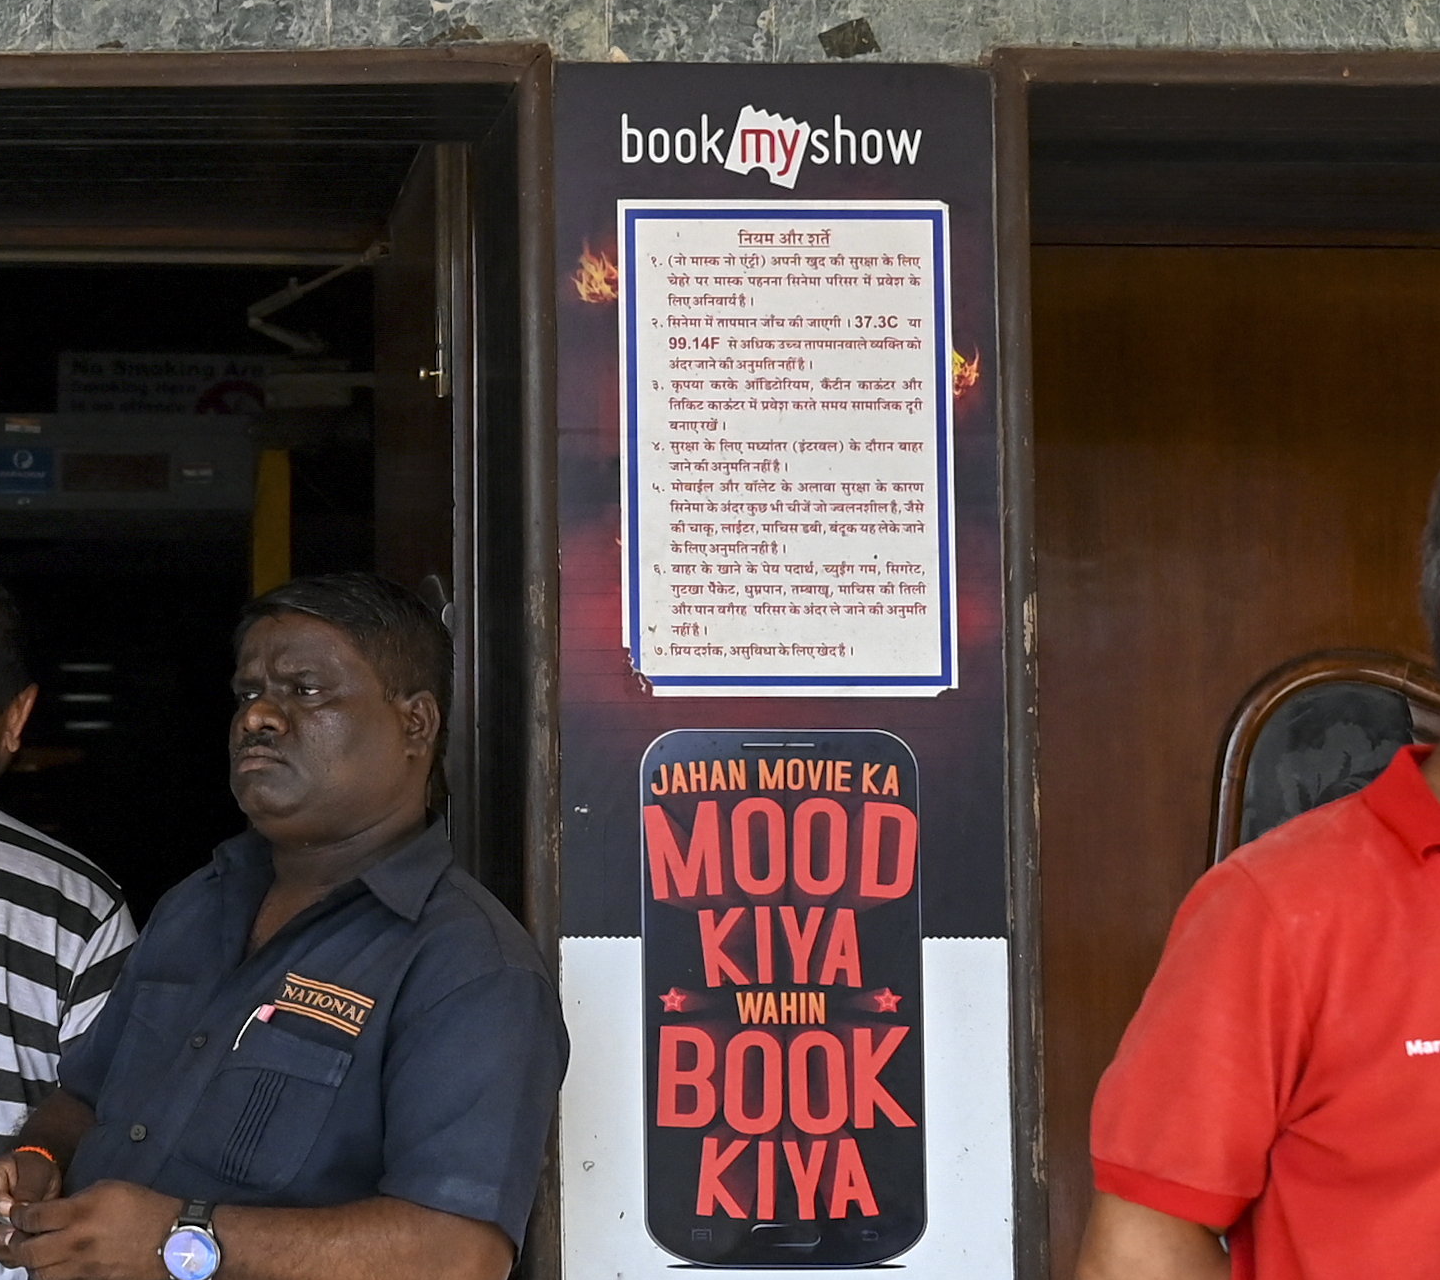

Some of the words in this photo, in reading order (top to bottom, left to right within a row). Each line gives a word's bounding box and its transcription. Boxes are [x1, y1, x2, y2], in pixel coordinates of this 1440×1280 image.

[621, 104, 922, 190] bookmyshow
[737, 229, 775, 246] नियम
[778, 229, 803, 246] और
[853, 315, 899, 329] 37.3C
[668, 336, 720, 351] 99.14F
[651, 760, 747, 796] JAHAN
[758, 759, 852, 792] MOVIE
[861, 763, 899, 797] KA
[642, 797, 918, 900] MOOD
[698, 906, 862, 988] KIYA
[281, 983, 368, 1025] NATIONAL
[735, 991, 826, 1025] WAHIN
[656, 1025, 918, 1135] BOOK
[695, 1137, 880, 1221] KIYA
